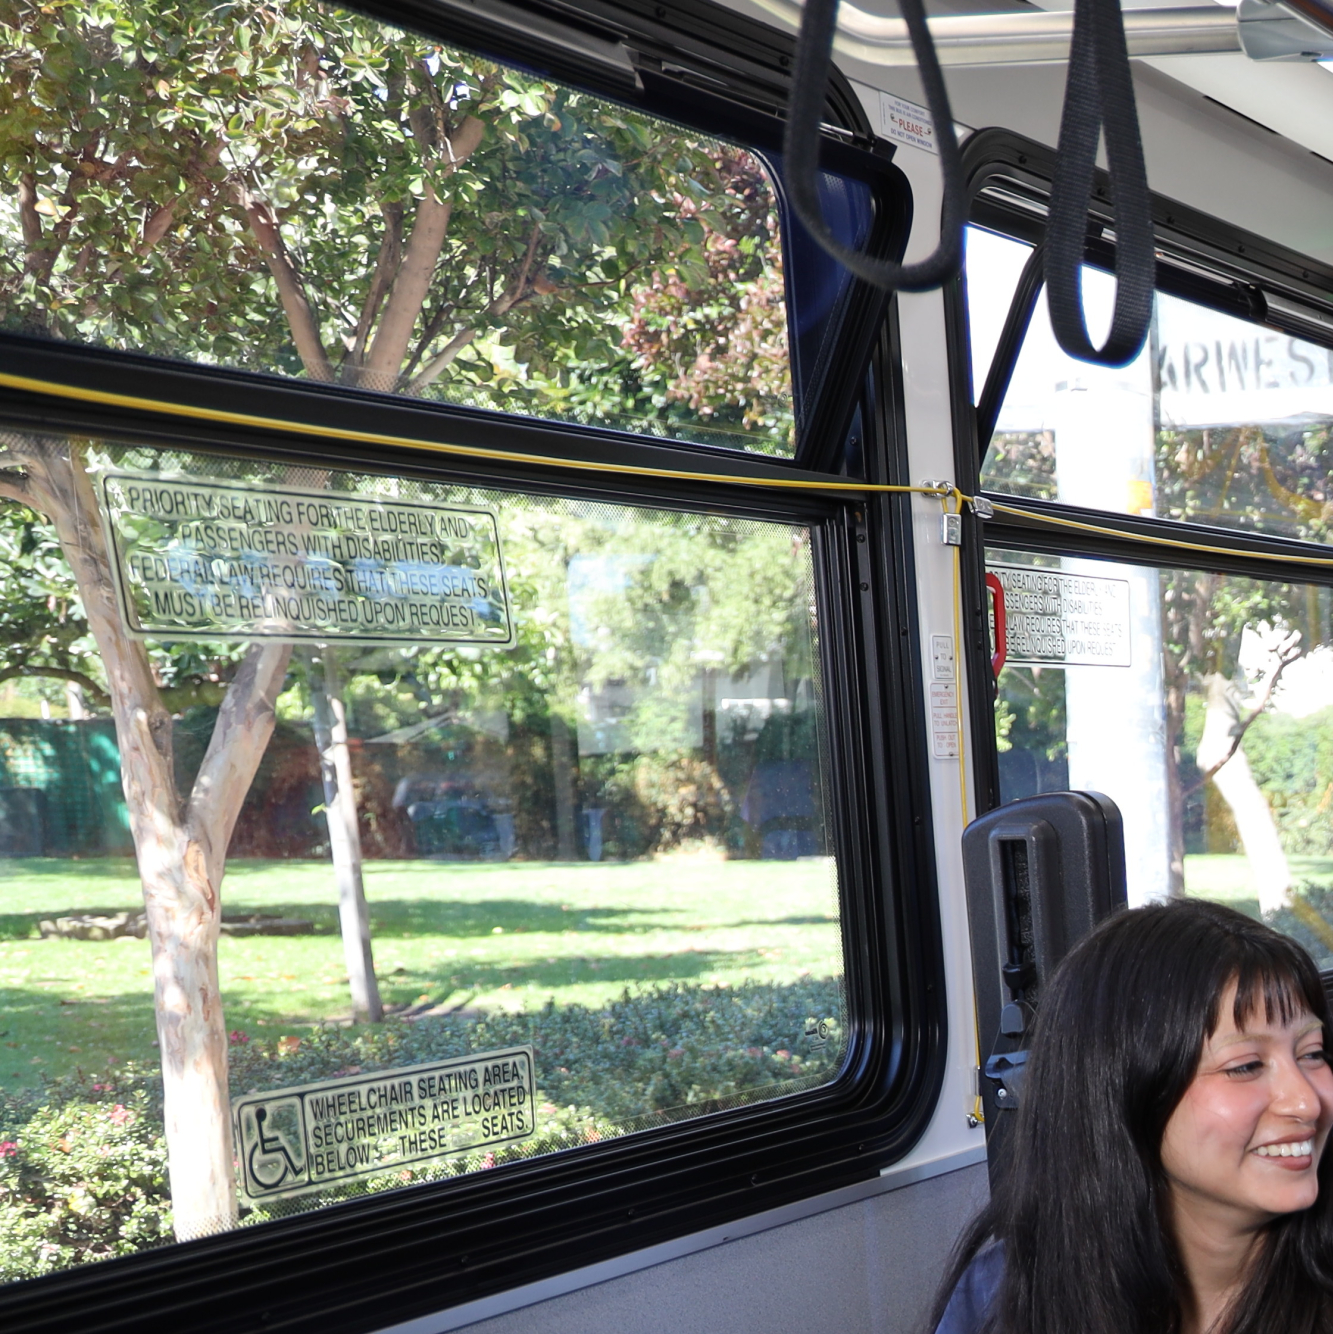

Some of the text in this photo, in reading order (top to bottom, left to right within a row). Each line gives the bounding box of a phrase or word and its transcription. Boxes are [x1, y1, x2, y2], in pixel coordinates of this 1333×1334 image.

[899, 118, 924, 137] PLEASE
[129, 487, 469, 540] PRIORITY SEATING FOR THE ELDERLY AND
[182, 523, 298, 556] PASSENGERS
[301, 534, 343, 560] WITH
[130, 555, 488, 599] FEDERAL LAW REQUIRES THAT THESE SEATS
[1012, 573, 1043, 591] SEATING
[1044, 576, 1059, 593] FOR
[1059, 578, 1073, 594] THE
[1074, 580, 1102, 596] ELDER
[154, 593, 209, 618] MUST
[213, 596, 237, 619] BE
[239, 596, 359, 625] RELINQUISHED
[363, 601, 406, 626] UPON
[1005, 593, 1043, 612] SSENGERS
[1044, 596, 1062, 615] WITH
[1010, 614, 1024, 632] LAW
[1026, 615, 1061, 636] REQUIRES
[1062, 619, 1079, 635] THAT
[1080, 620, 1100, 637] THESE
[1016, 635, 1066, 655] RELINQUISHED
[1066, 640, 1086, 655] UPON
[310, 1081, 415, 1121] WHEELCHAIR
[418, 1068, 479, 1100] SEATING
[312, 1085, 526, 1149] SECUREMENTS ARE LOCATED
[315, 1143, 371, 1176] BELOW
[400, 1127, 447, 1157] THESE
